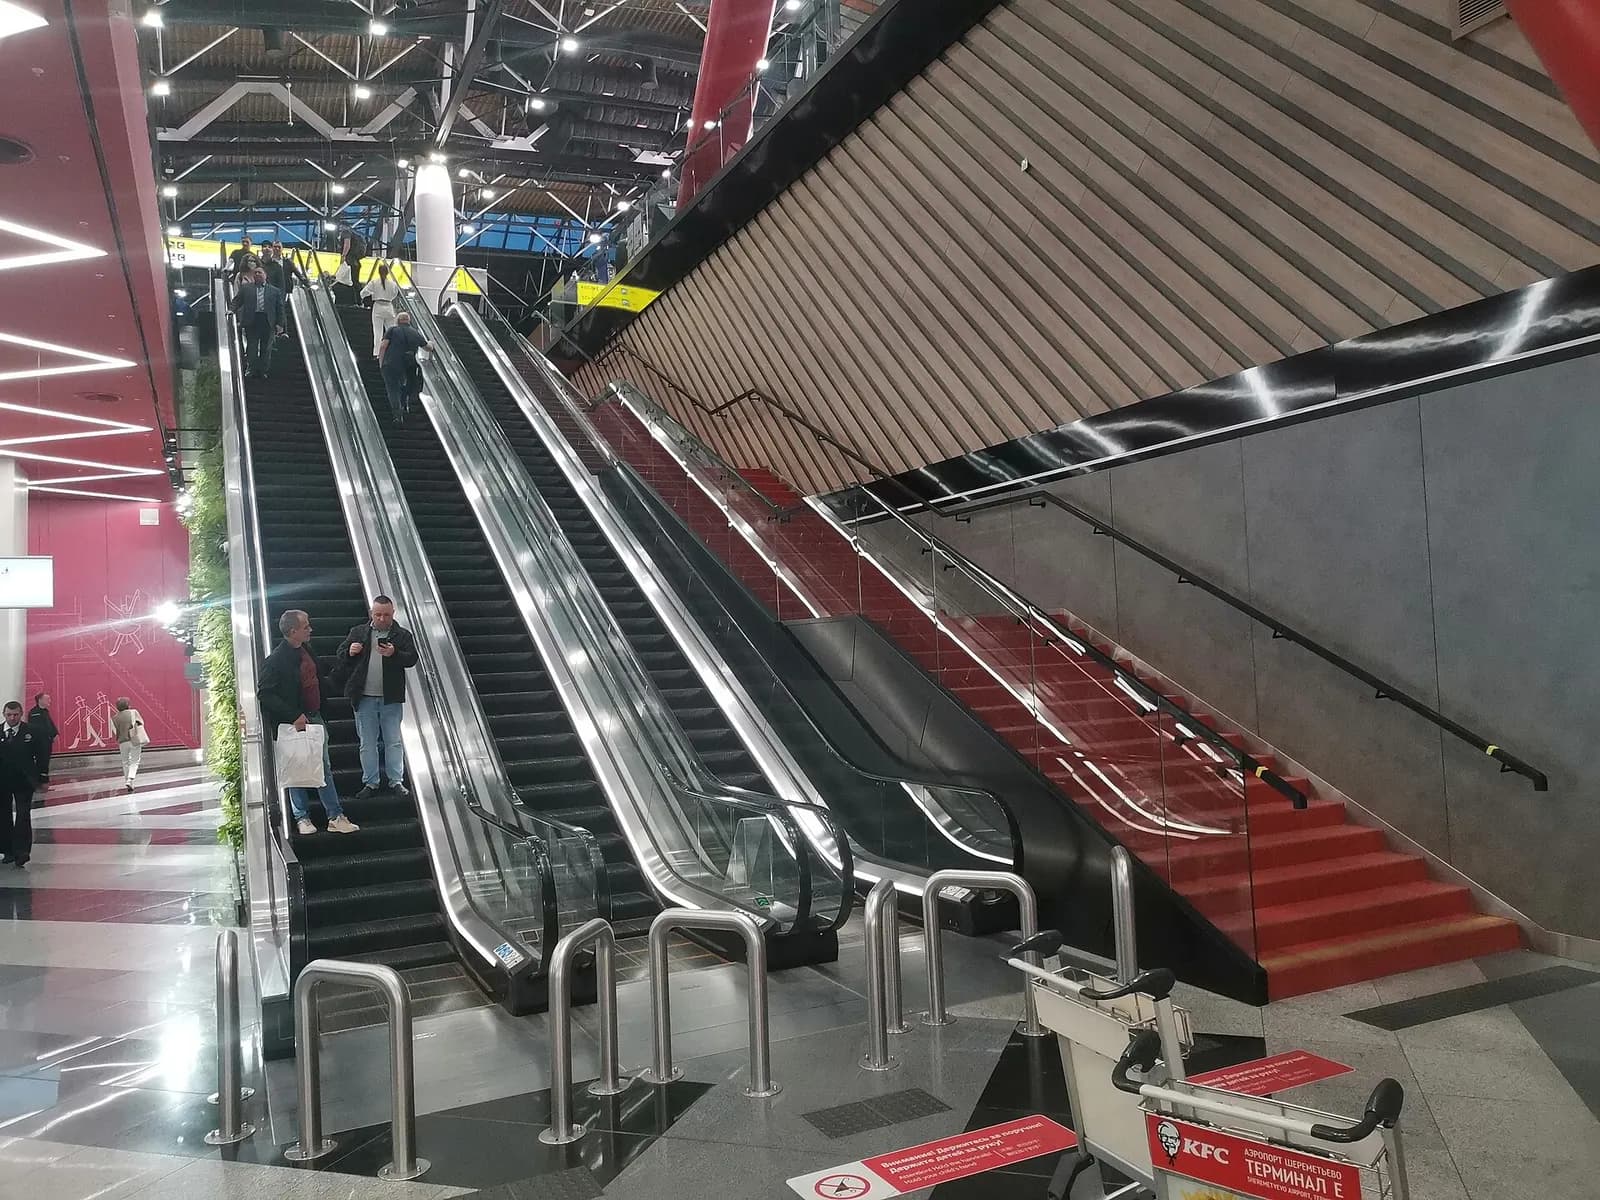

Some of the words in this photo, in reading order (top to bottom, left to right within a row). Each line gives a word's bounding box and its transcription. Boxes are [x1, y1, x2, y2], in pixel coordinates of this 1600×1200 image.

[881, 1151, 936, 1168] Внимание!
[936, 1137, 989, 1154] Держитесь
[889, 1158, 935, 1174] Держите
[935, 1150, 965, 1162] детей
[1182, 1137, 1229, 1165] KFC
[1244, 1148, 1282, 1165] АЭРОПОРТ
[1284, 1158, 1342, 1180] ШЕРЕМЕТЬЕВО
[1245, 1158, 1327, 1194] ТЕРМИНАЛ
